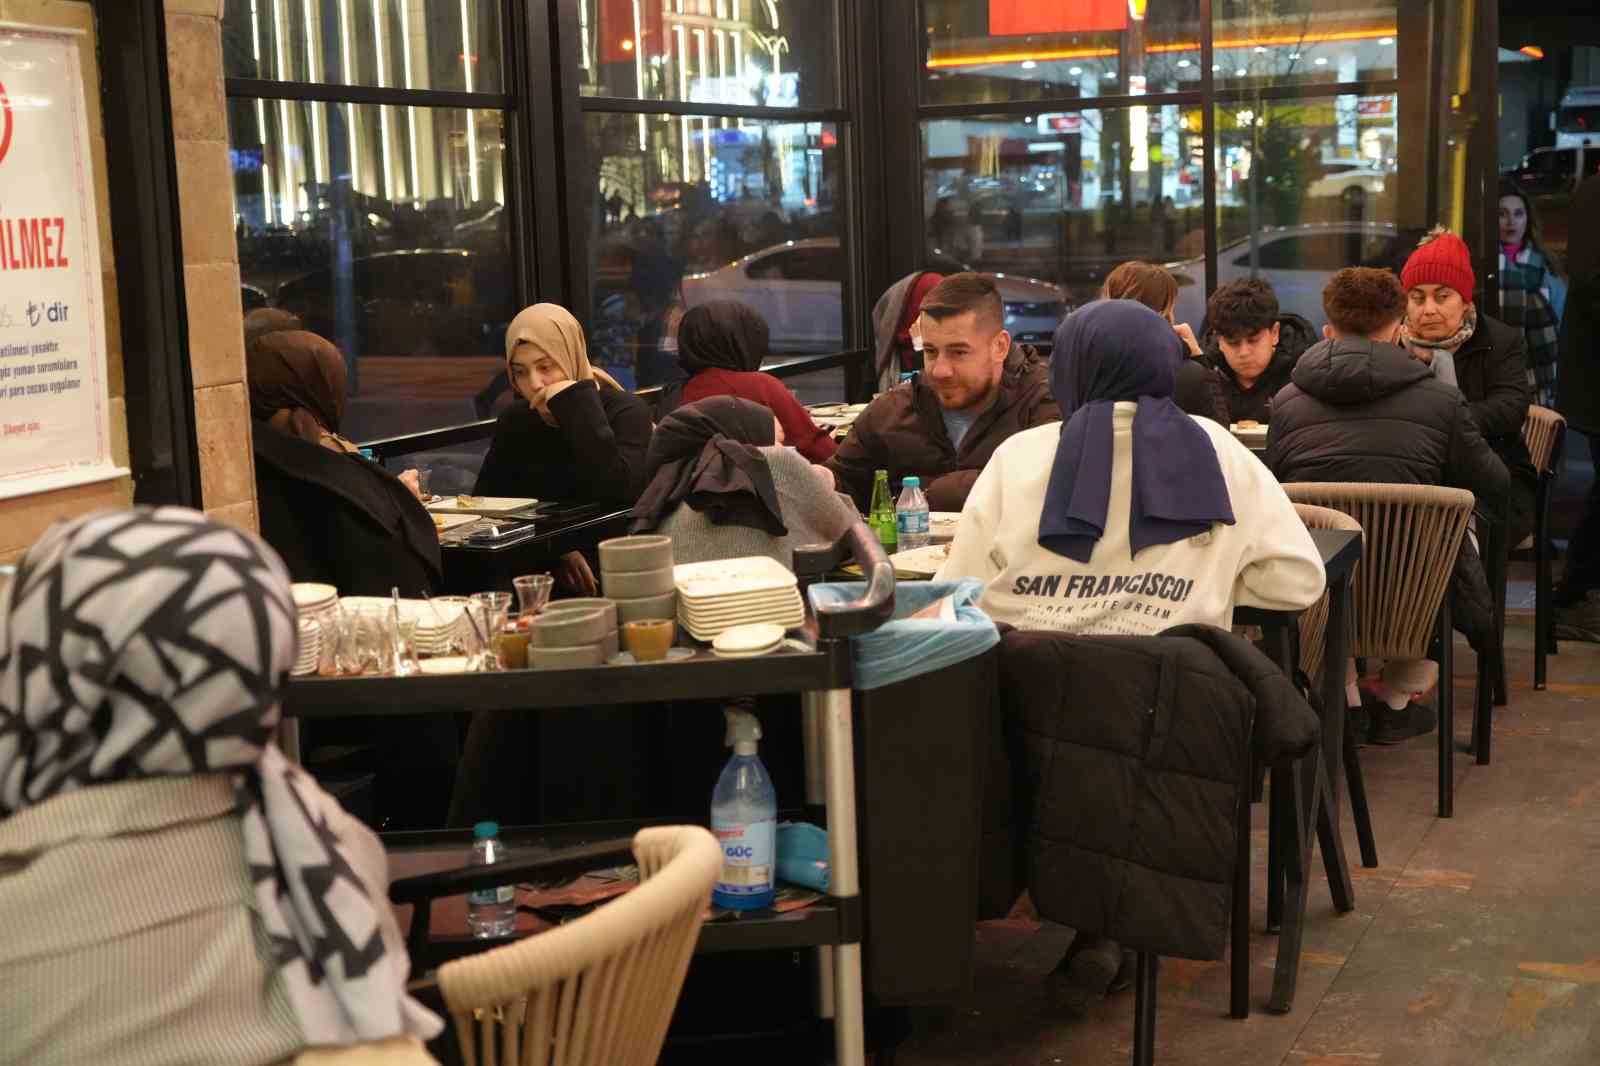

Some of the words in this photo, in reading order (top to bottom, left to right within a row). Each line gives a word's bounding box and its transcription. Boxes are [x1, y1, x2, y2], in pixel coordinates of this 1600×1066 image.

[1012, 575, 1062, 597] SAN
[1064, 572, 1195, 602] FRANCISCO!
[726, 844, 752, 859] GÜÇ
